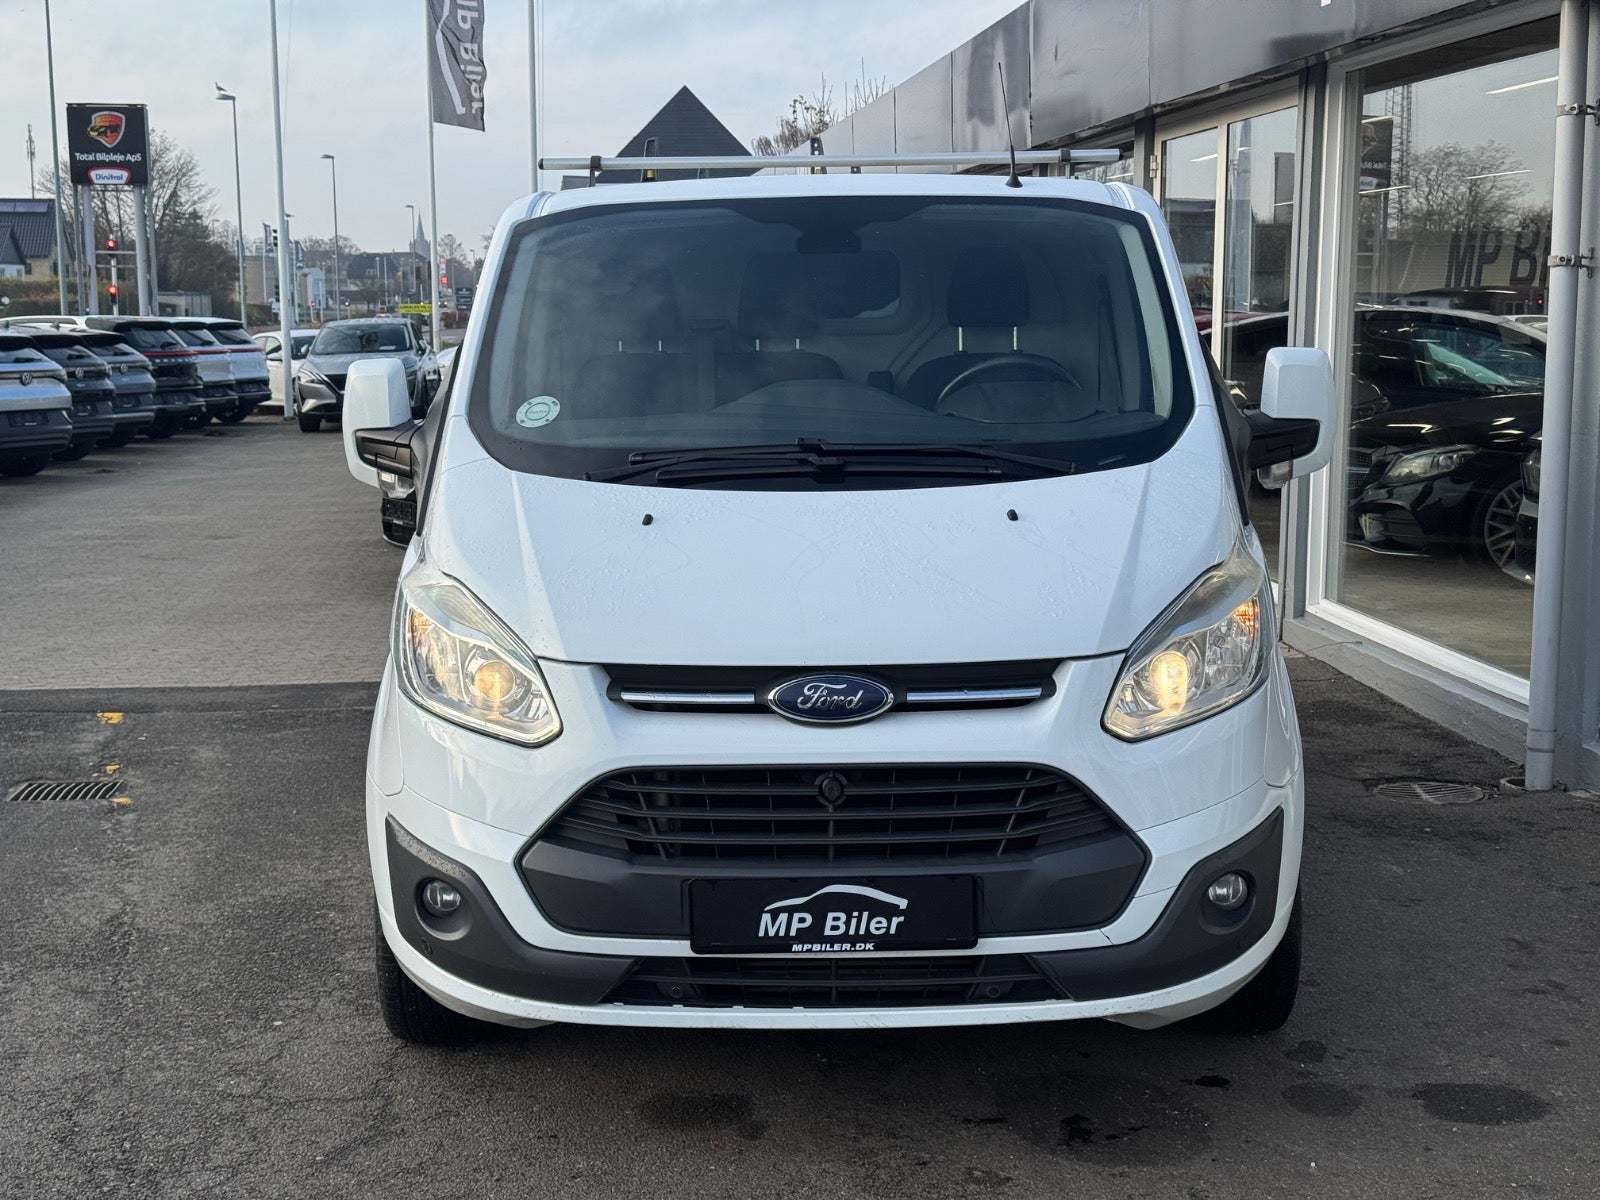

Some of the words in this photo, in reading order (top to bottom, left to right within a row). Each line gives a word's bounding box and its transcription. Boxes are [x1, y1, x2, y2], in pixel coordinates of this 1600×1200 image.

[75, 152, 95, 161] Total
[96, 152, 125, 163] Bilpleje
[126, 153, 142, 163] ApS
[95, 173, 123, 181] Dinitrol
[1444, 226, 1504, 289] MP
[797, 682, 864, 710] Ford
[758, 912, 813, 937] MP
[823, 911, 905, 936] Biler
[791, 942, 876, 952] MPBILER.DK
